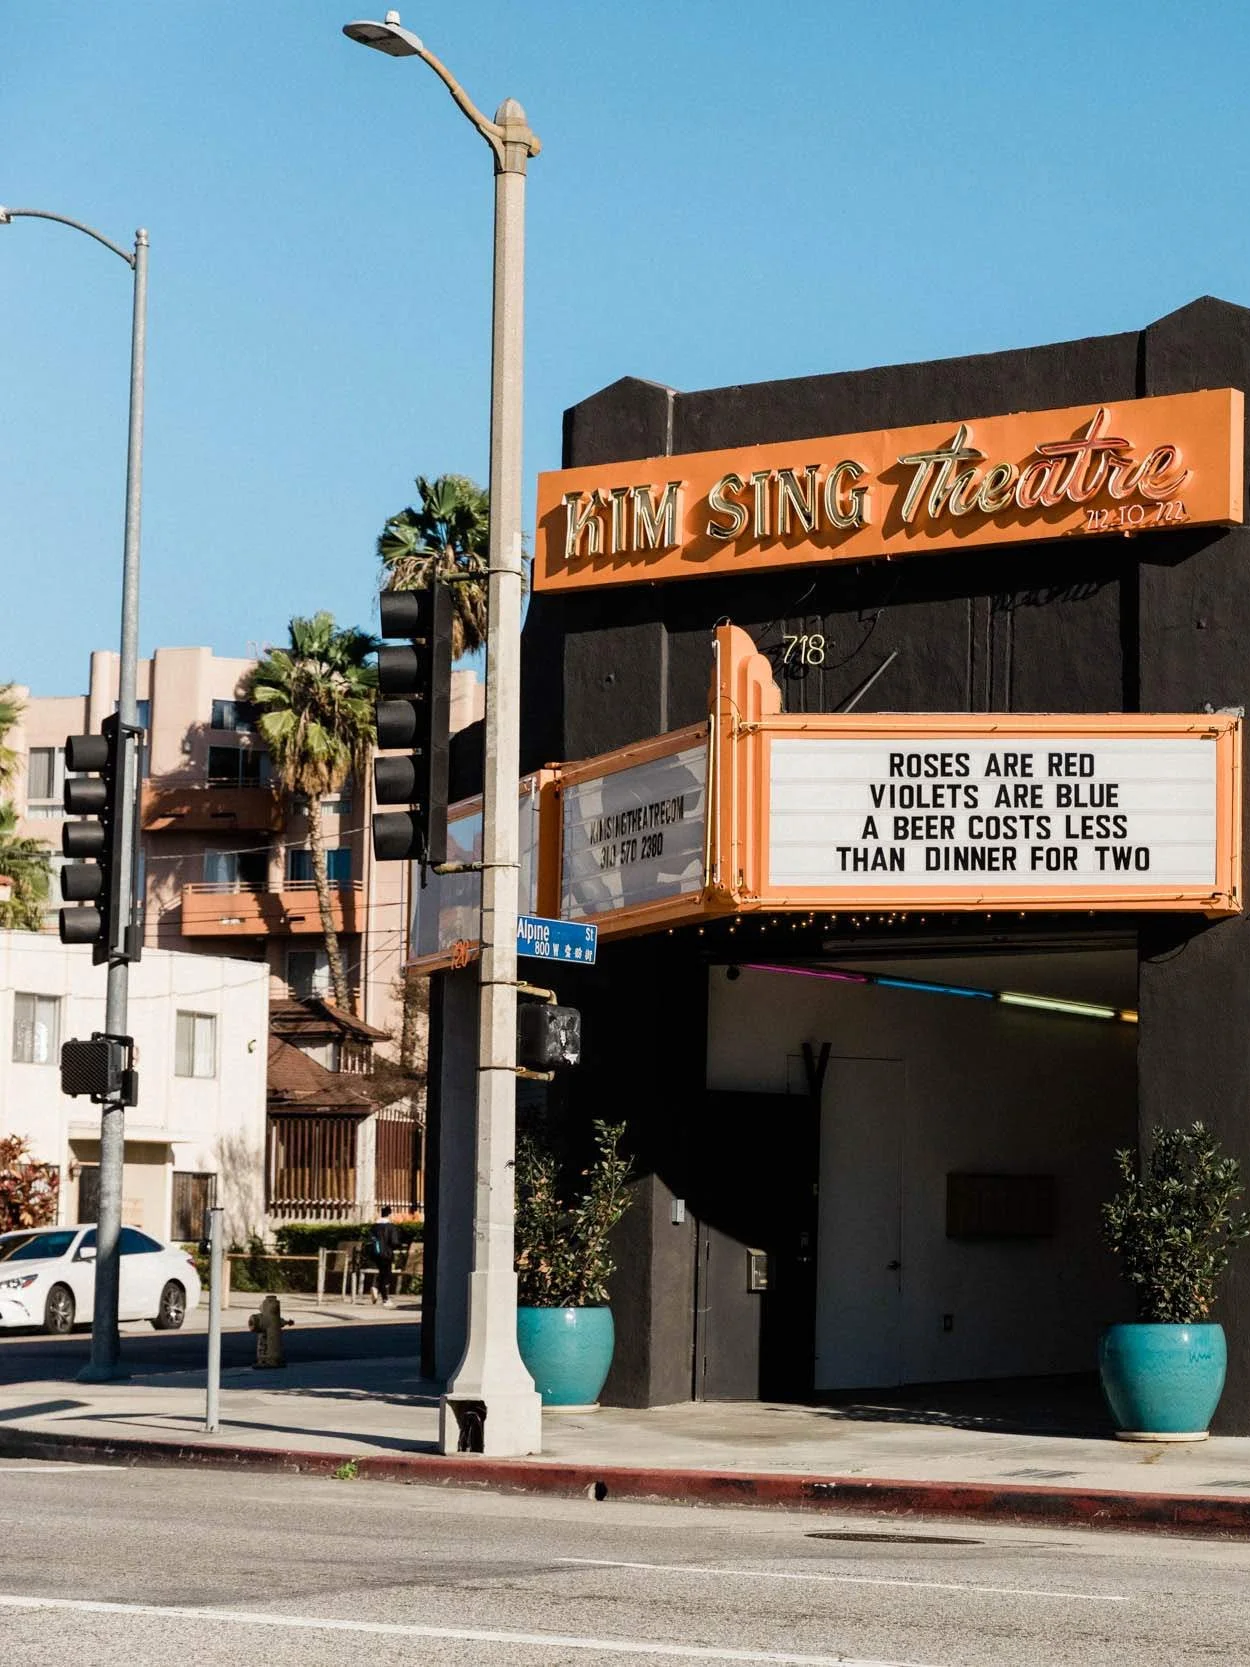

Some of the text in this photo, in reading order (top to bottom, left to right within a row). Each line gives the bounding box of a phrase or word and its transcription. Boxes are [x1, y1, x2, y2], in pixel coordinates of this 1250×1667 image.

[562, 407, 1190, 558] KIM SING Theatre
[1086, 500, 1183, 530] 712 TO 722
[782, 633, 825, 665] 718
[890, 753, 1094, 777] ROSES ARE RED
[870, 784, 1118, 808] VIOLETS ARE BLUE
[862, 815, 1127, 840] A BEER COSTS LESS
[620, 838, 637, 865] 570
[641, 832, 663, 860] 2380
[837, 847, 1149, 871] THAN DINNER FOR TWO
[517, 918, 594, 944] Alpine St
[534, 941, 550, 956] 800
[552, 943, 560, 957] W
